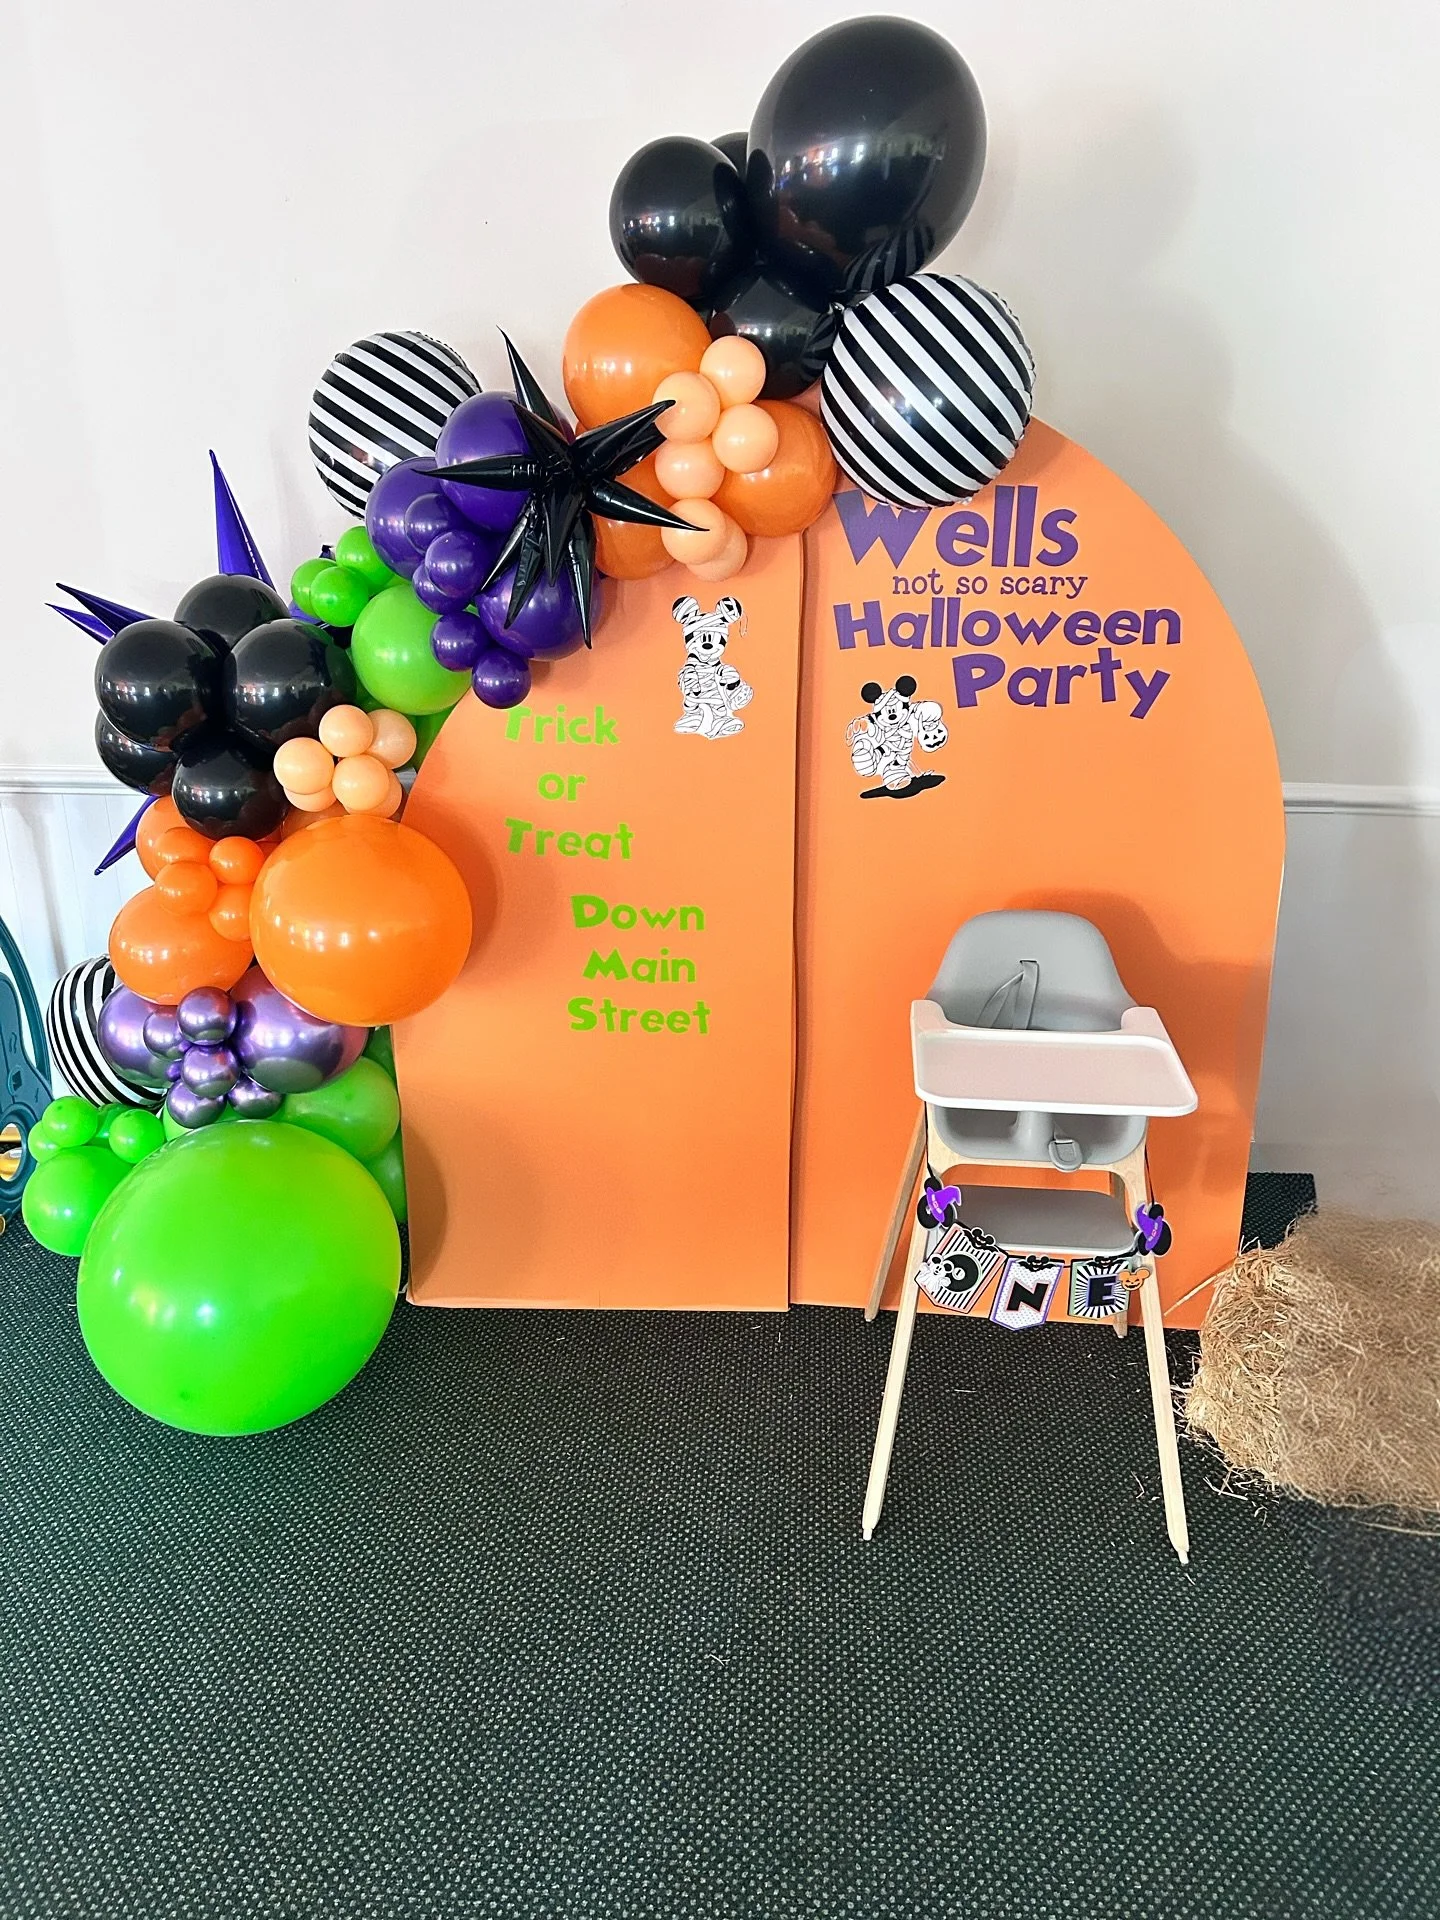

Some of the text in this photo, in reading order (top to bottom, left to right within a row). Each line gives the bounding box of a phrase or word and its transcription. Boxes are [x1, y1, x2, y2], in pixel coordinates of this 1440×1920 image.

[832, 485, 1079, 569] Wells
[892, 568, 1088, 599] not so scary
[833, 597, 1181, 650] Halloween
[951, 647, 1171, 720] Party
[504, 704, 620, 745] Trick
[537, 772, 586, 802] or
[504, 816, 634, 860] Treat
[570, 894, 705, 931] Down
[582, 947, 696, 983] Main
[567, 996, 711, 1034] Street
